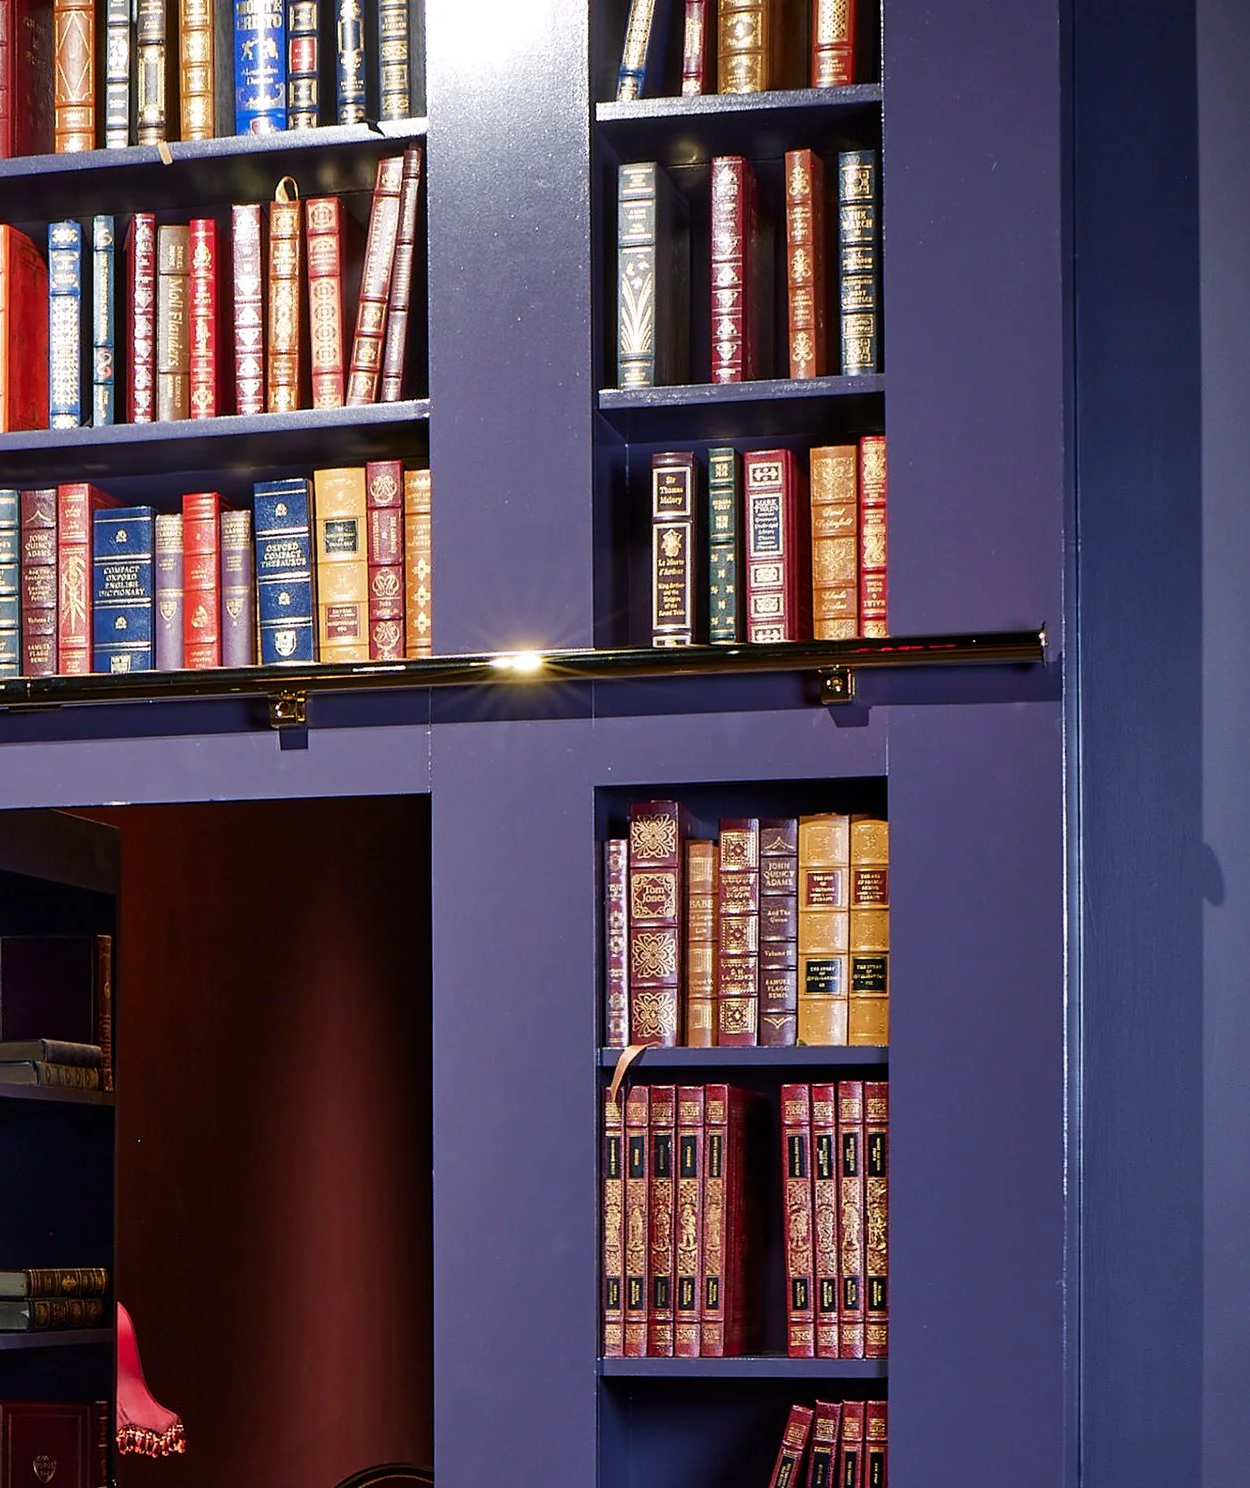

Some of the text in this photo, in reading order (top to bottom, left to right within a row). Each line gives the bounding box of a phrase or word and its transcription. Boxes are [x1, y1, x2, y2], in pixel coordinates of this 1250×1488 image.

[167, 278, 183, 368] Moll Flanders
[659, 486, 684, 495] Thomas
[28, 534, 49, 543] JOHN
[25, 542, 52, 551] QUINCY
[265, 542, 299, 552] OXFORD
[26, 549, 51, 558] ADAMS
[263, 550, 302, 561] COMPACT
[260, 557, 307, 568] THESAURUS
[103, 565, 141, 575] COMPACT
[105, 573, 138, 581] OXFORD
[104, 581, 139, 590] ENGLISH
[98, 588, 146, 597] DICTIONARY
[768, 862, 790, 871] JOHN
[763, 869, 796, 879] QUINCY
[766, 876, 793, 887] ADAMS
[643, 884, 665, 895] Tom
[640, 892, 668, 905] Jones
[689, 899, 714, 910] BABE
[764, 950, 786, 958] Volume
[766, 985, 791, 993] FLAGG
[768, 991, 790, 1000] BEMIS
